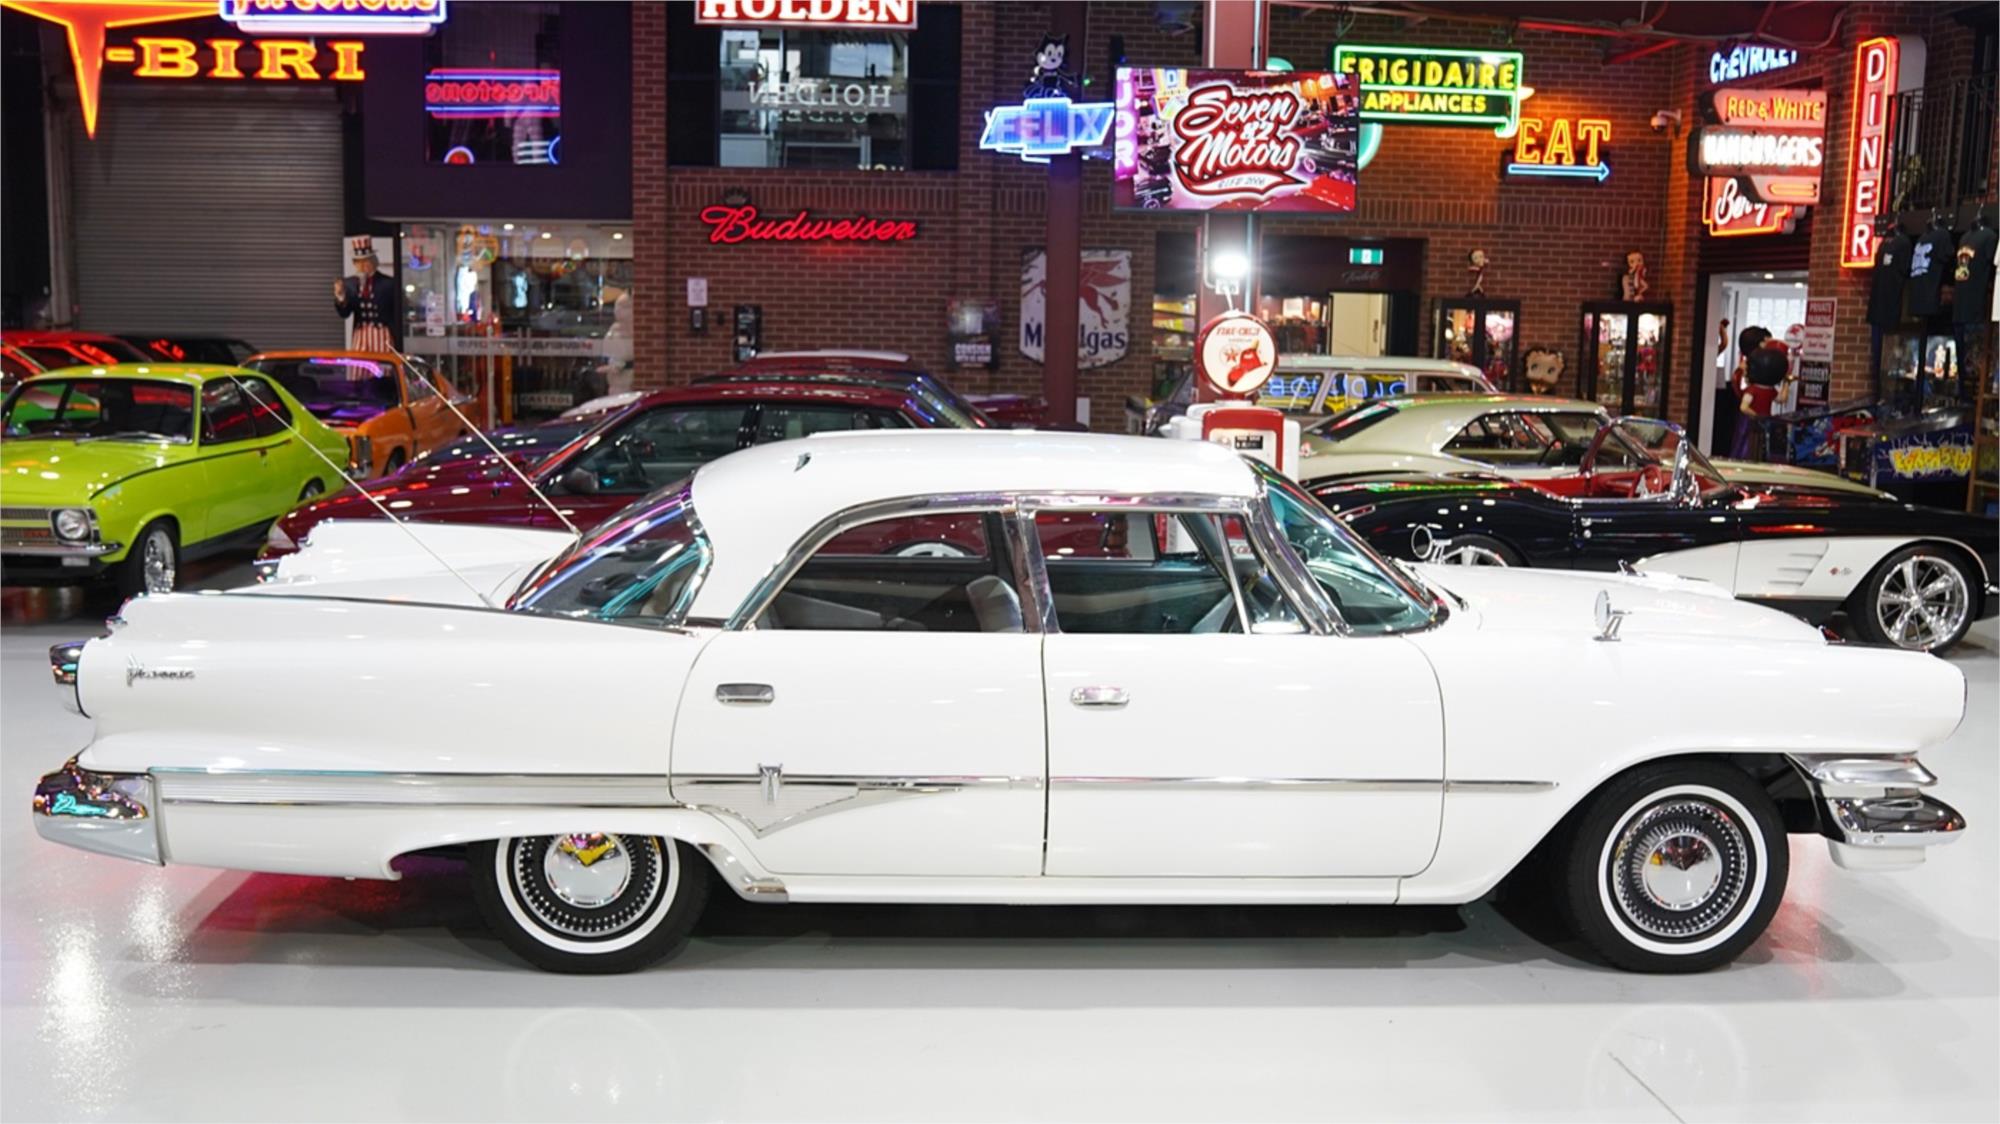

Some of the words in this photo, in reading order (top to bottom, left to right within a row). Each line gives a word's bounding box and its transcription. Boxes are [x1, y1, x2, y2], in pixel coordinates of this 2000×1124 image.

[702, 0, 908, 22] HOLDEN
[1341, 57, 1515, 89] FRIGIDAIRE
[1180, 88, 1292, 136] Seven
[1364, 92, 1487, 113] APPLIANCES
[1728, 97, 1755, 118] RED
[1758, 102, 1768, 119] &
[1773, 97, 1820, 120] WHITE
[996, 109, 1102, 144] FELIX
[1515, 119, 1611, 166] EAT
[1182, 131, 1294, 178] Motors
[1704, 134, 1823, 167] HAMBURGERS
[1852, 48, 1885, 256] DINER
[701, 206, 917, 242] Budweiser
[1024, 323, 1126, 356] Mlgas
